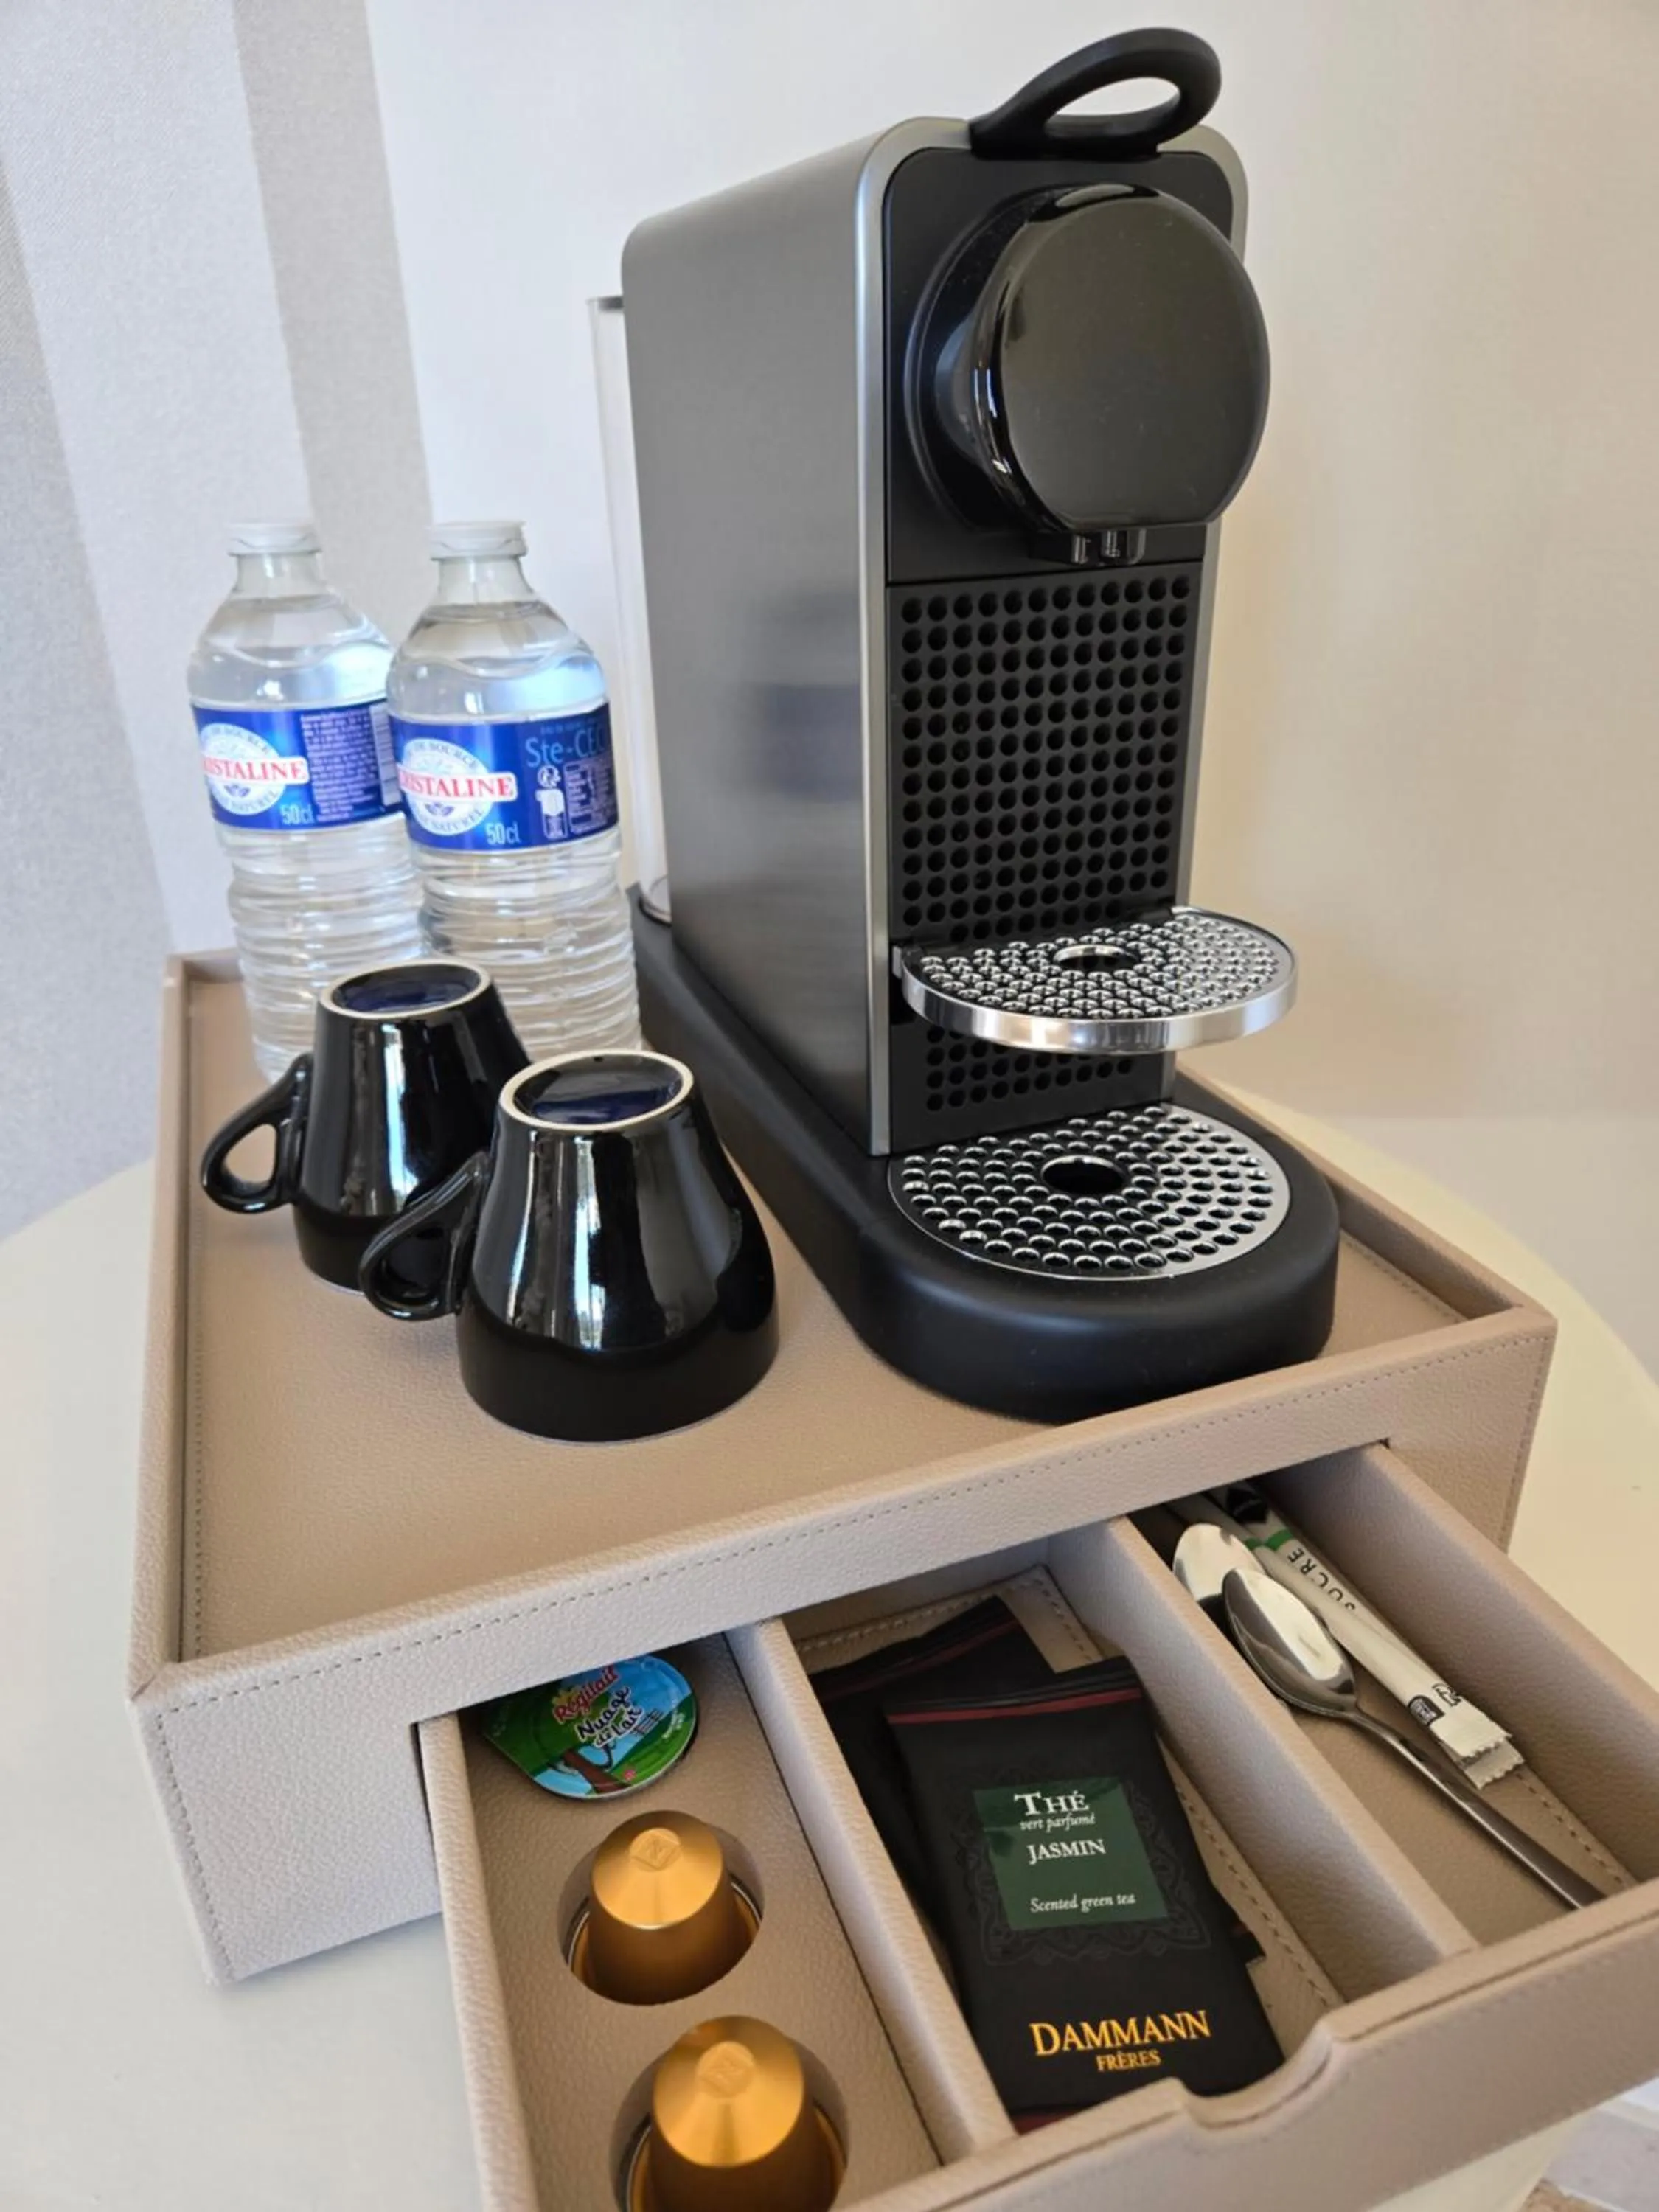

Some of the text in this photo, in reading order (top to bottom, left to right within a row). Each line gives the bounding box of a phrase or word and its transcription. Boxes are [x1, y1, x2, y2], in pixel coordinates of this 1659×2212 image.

[280, 804, 314, 826] 50cl
[485, 821, 521, 845] 50cl
[577, 1687, 630, 1738] Nuage
[1020, 1812, 1096, 1833] vert parfumé
[1026, 1839, 1107, 1865] JASMIN
[1030, 1893, 1136, 1913] Scented green tea
[1029, 2010, 1211, 2056] DAMMANN
[1096, 2048, 1162, 2073] FRÈRES
